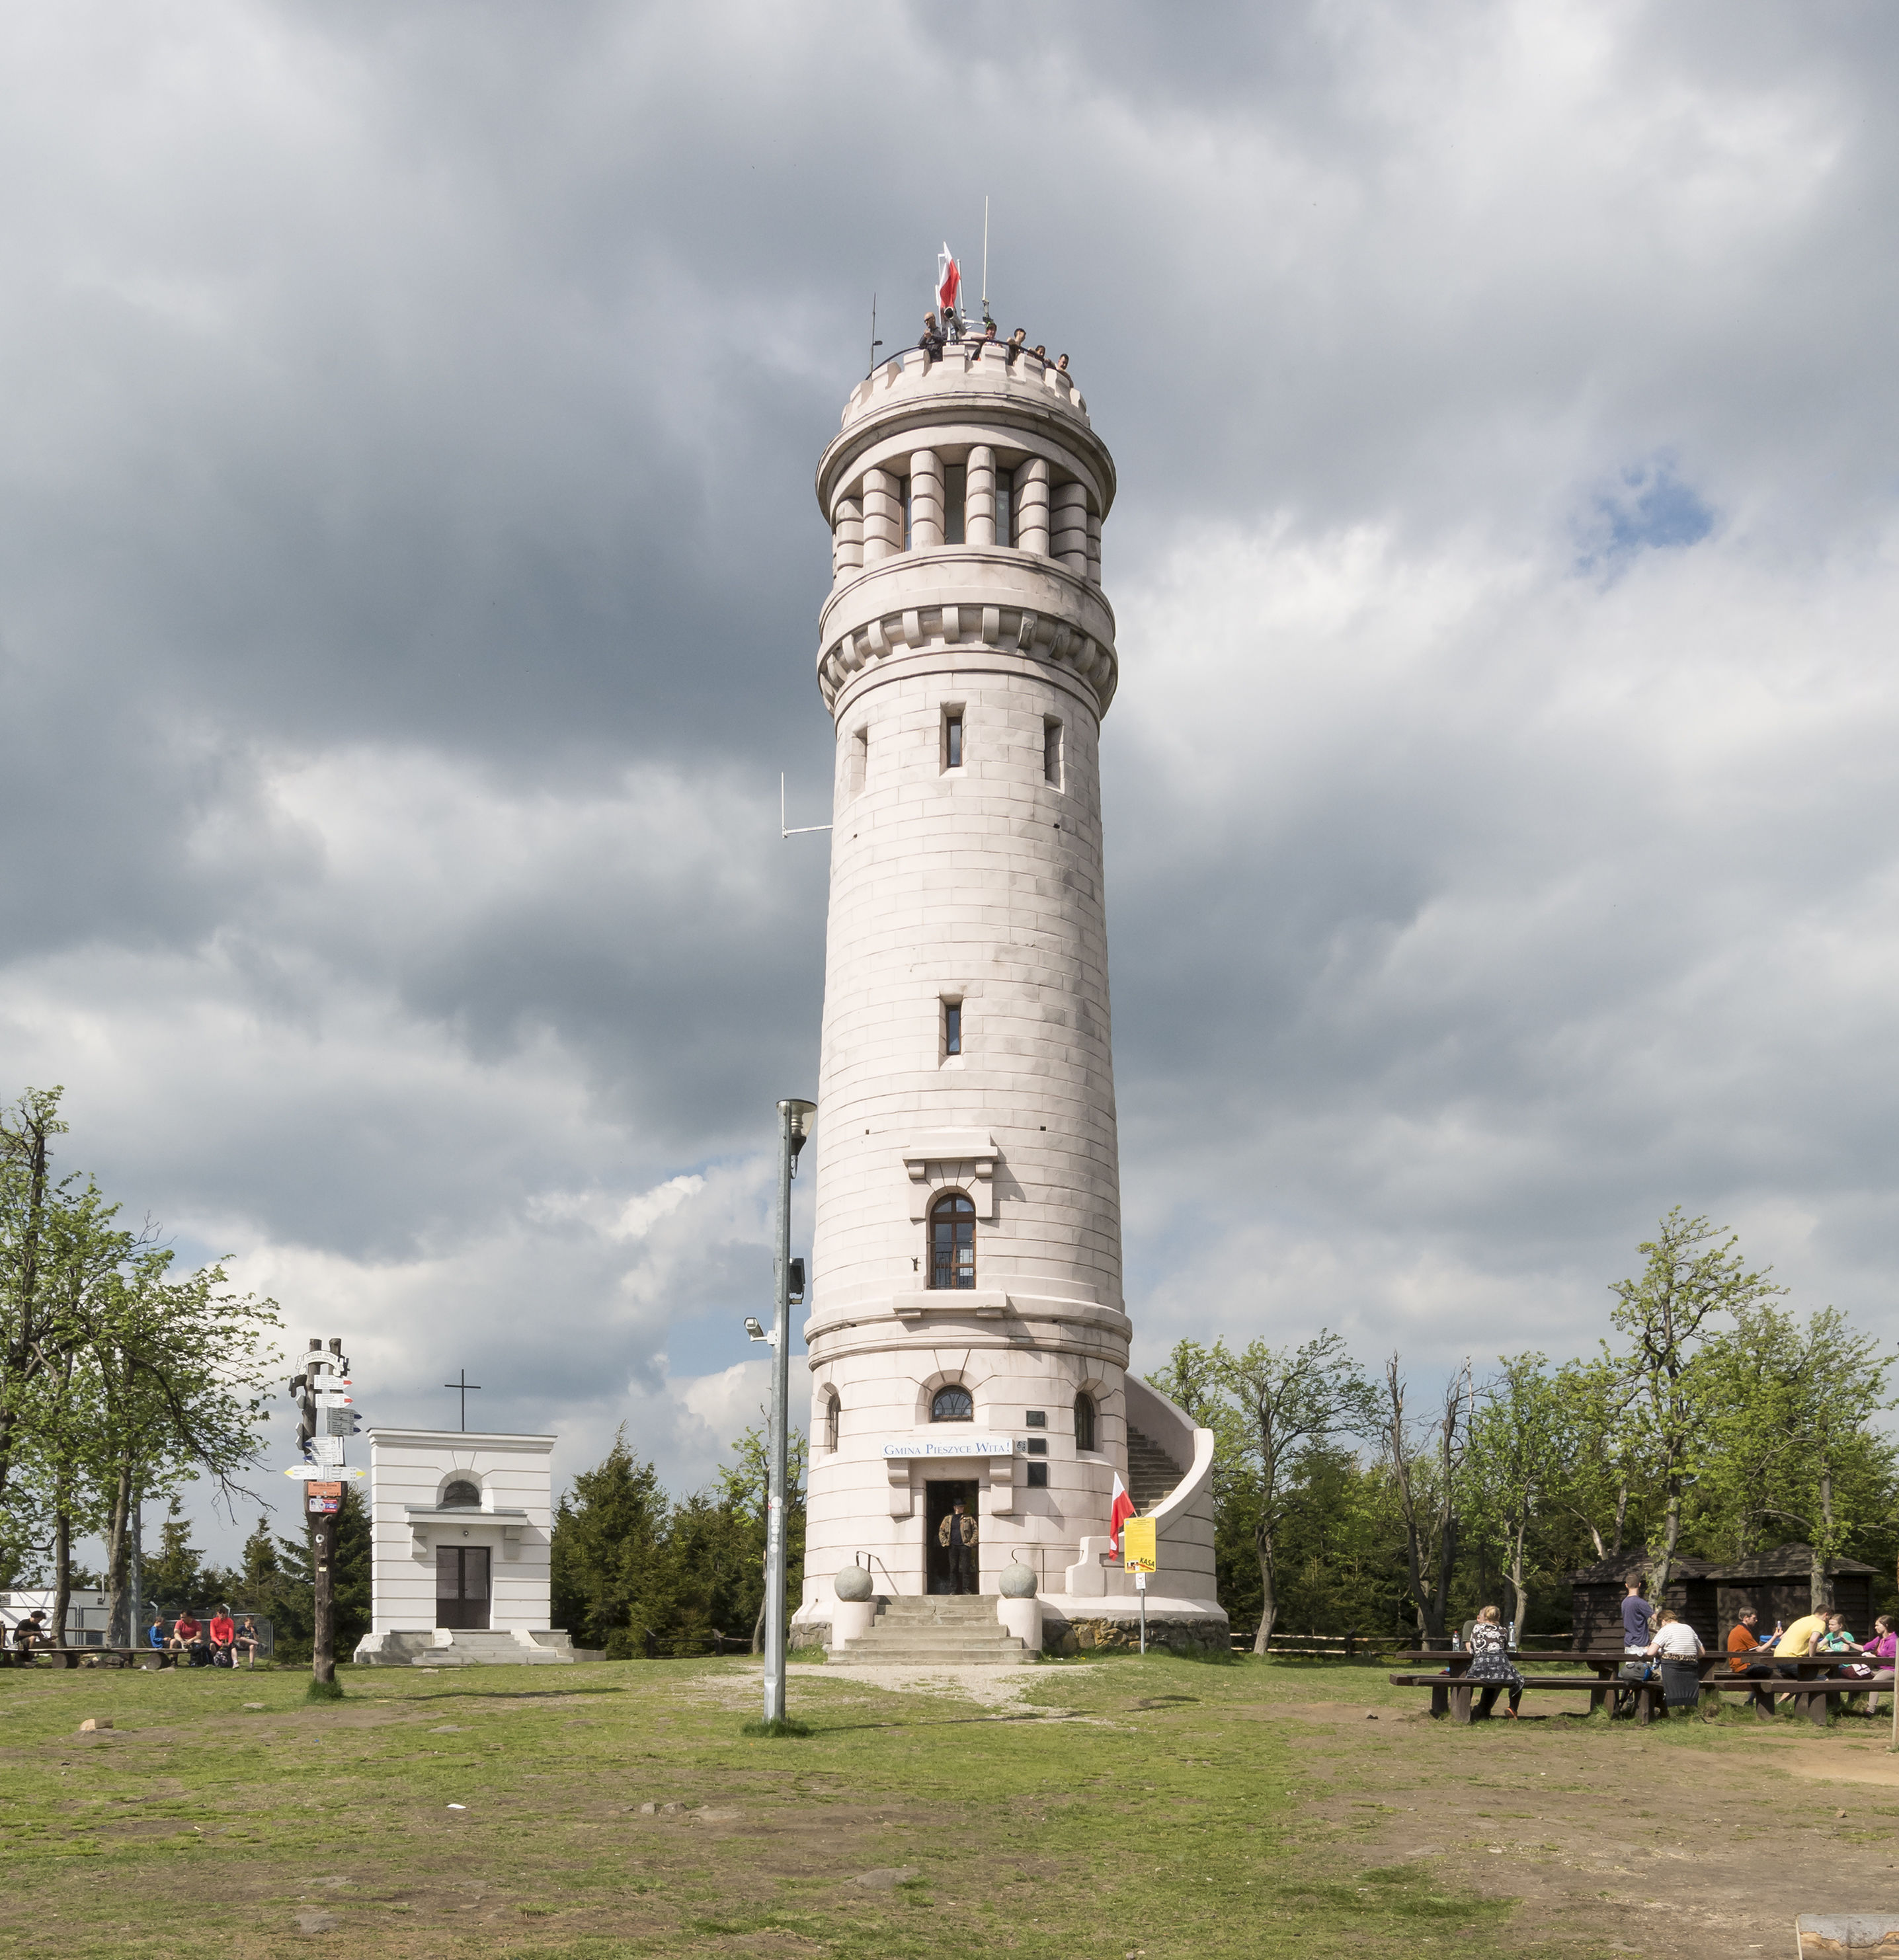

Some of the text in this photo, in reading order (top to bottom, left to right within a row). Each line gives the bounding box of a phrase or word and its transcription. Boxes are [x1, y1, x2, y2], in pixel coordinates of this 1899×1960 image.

[885, 1442, 1010, 1455] GMINA PIESZYCE WITA!
[1140, 1557, 1154, 1567] KASA
